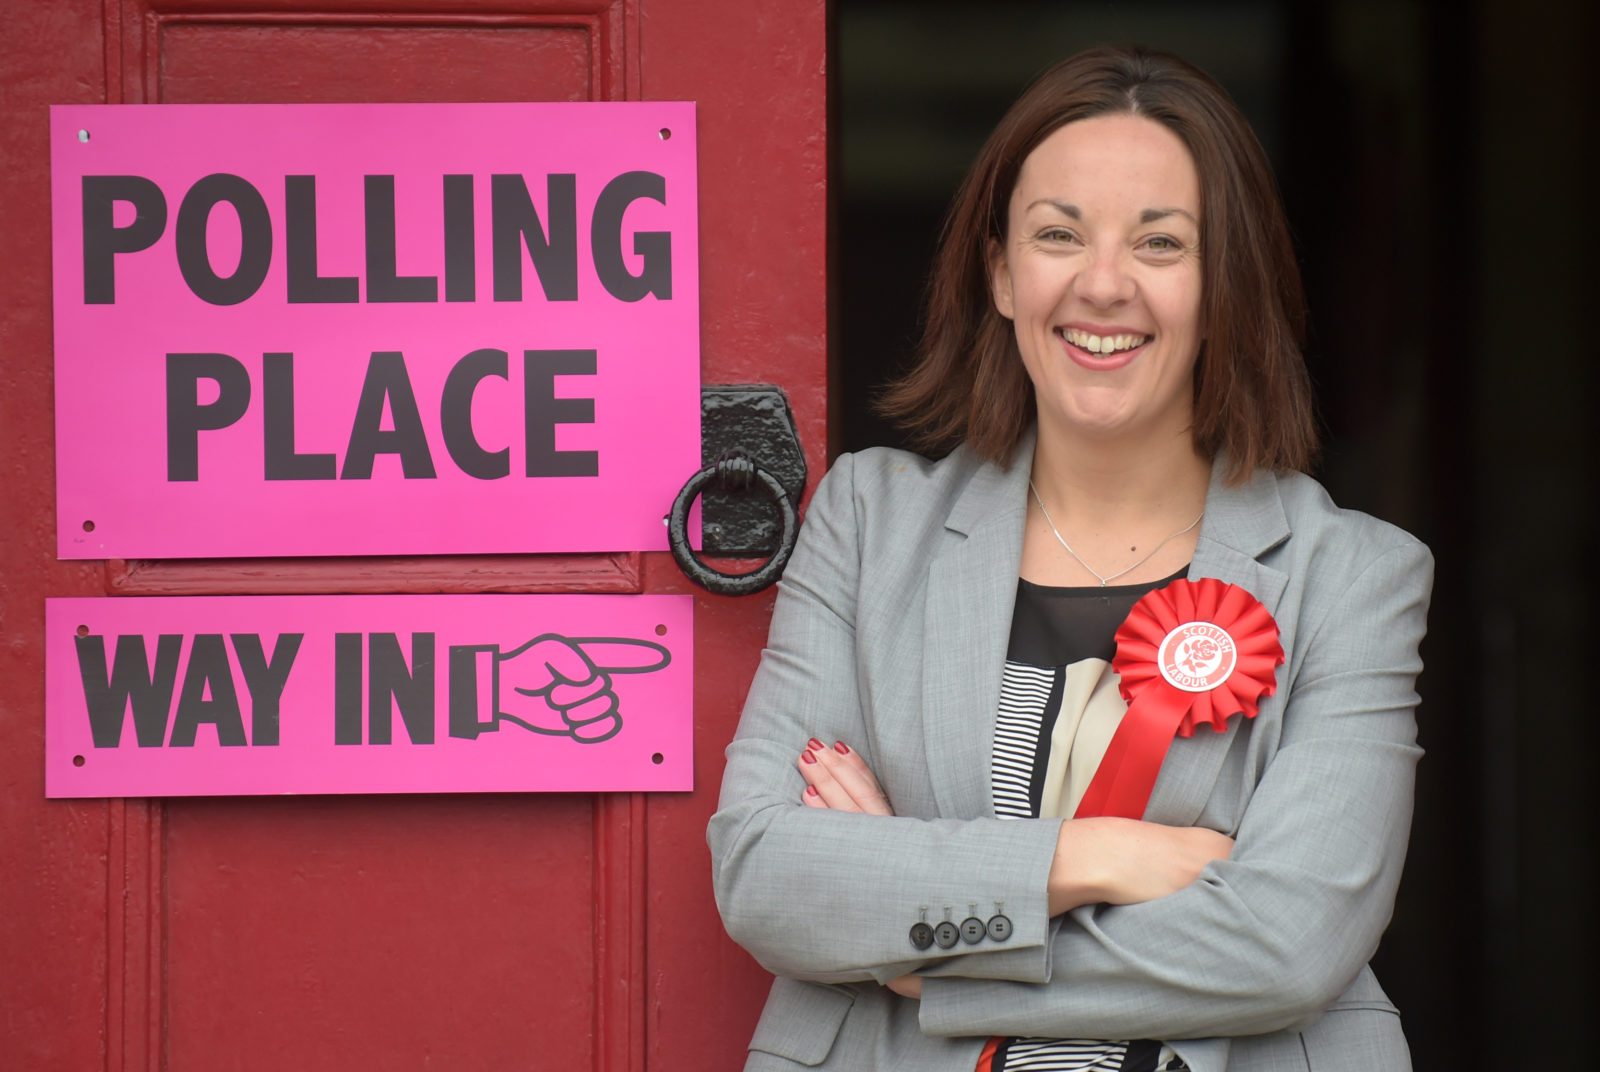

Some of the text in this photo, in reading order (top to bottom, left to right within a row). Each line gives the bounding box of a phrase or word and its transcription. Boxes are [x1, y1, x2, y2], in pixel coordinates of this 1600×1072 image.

[82, 171, 673, 306] POLLING
[165, 348, 599, 482] PLACE
[74, 632, 435, 748] WAY IN
[1166, 663, 1208, 687] LABOUR
[1182, 626, 1232, 653] SCOTTISH
